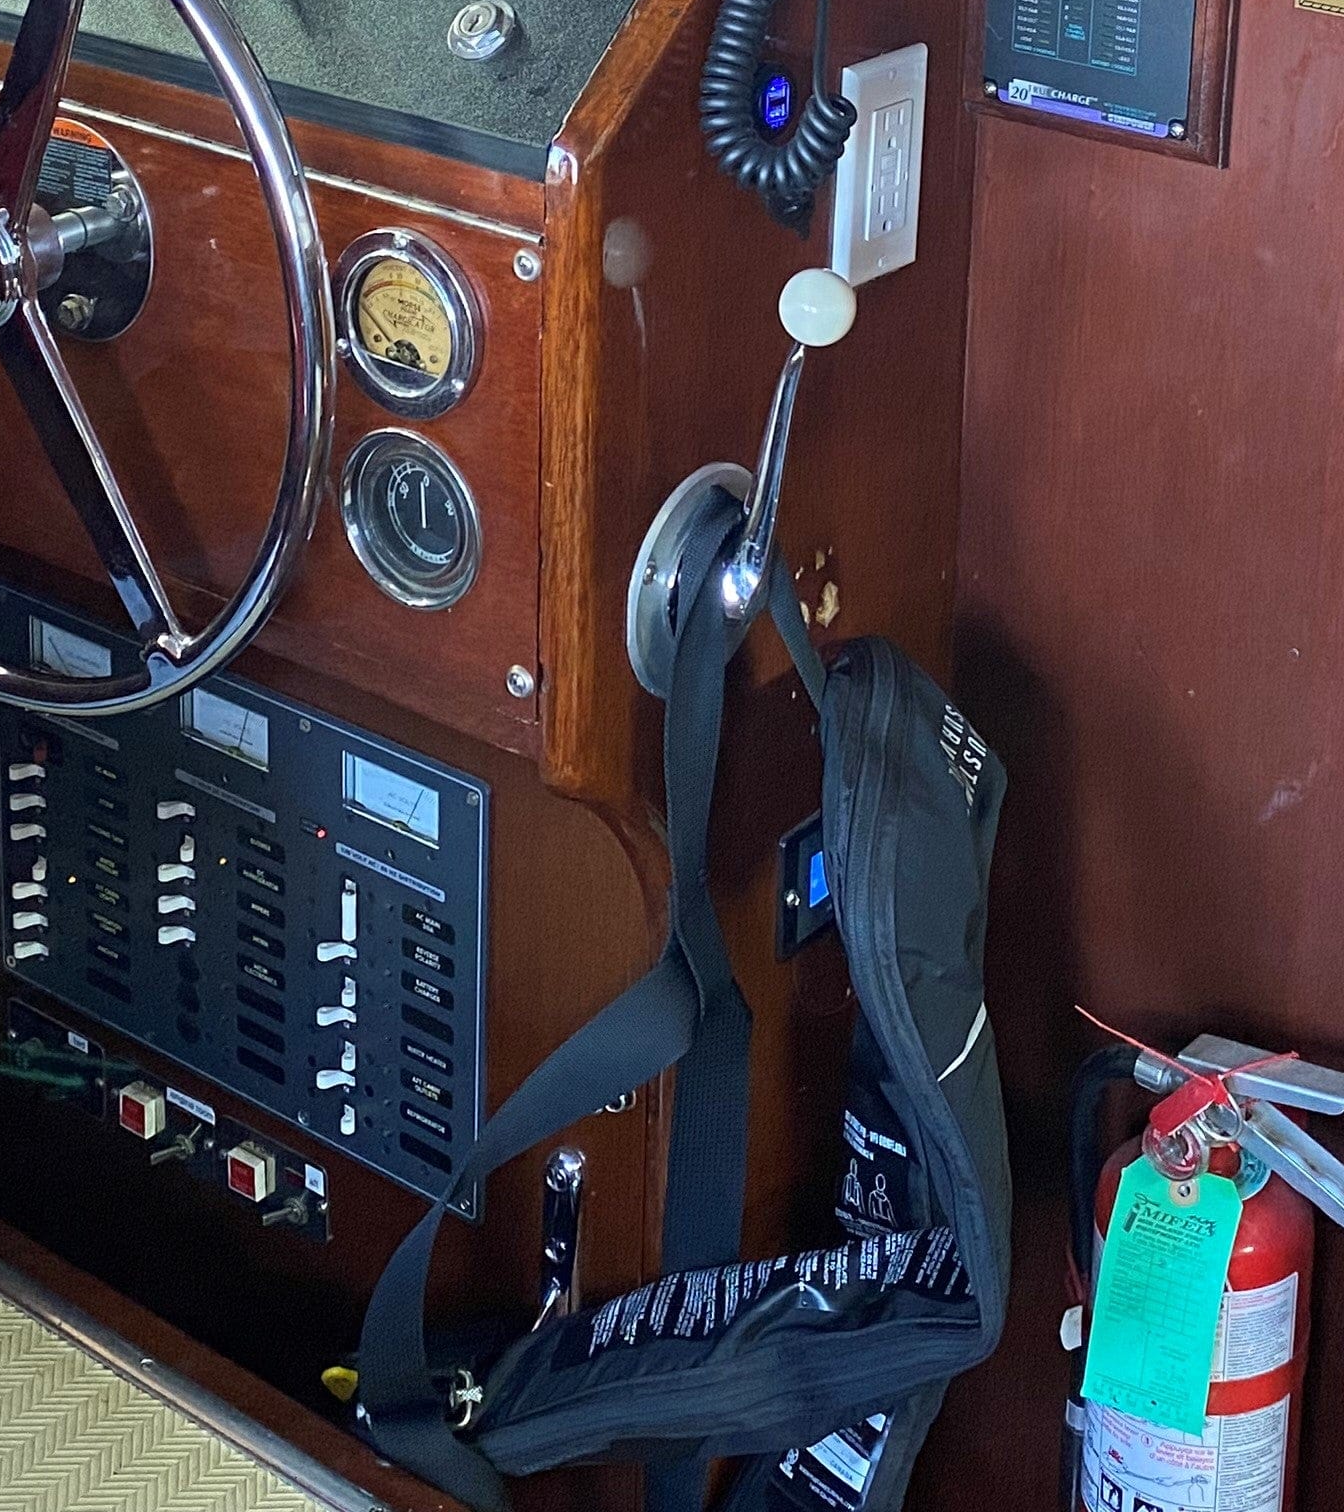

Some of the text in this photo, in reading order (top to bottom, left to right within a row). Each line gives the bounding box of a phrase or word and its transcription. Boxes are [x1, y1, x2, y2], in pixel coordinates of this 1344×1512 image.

[1010, 87, 1029, 102] 20
[424, 917, 441, 929] MAIN
[414, 953, 441, 970] POLARITY
[416, 946, 439, 962] REVERSE
[414, 986, 440, 1003] CHARGER
[415, 978, 439, 995] BATTERY
